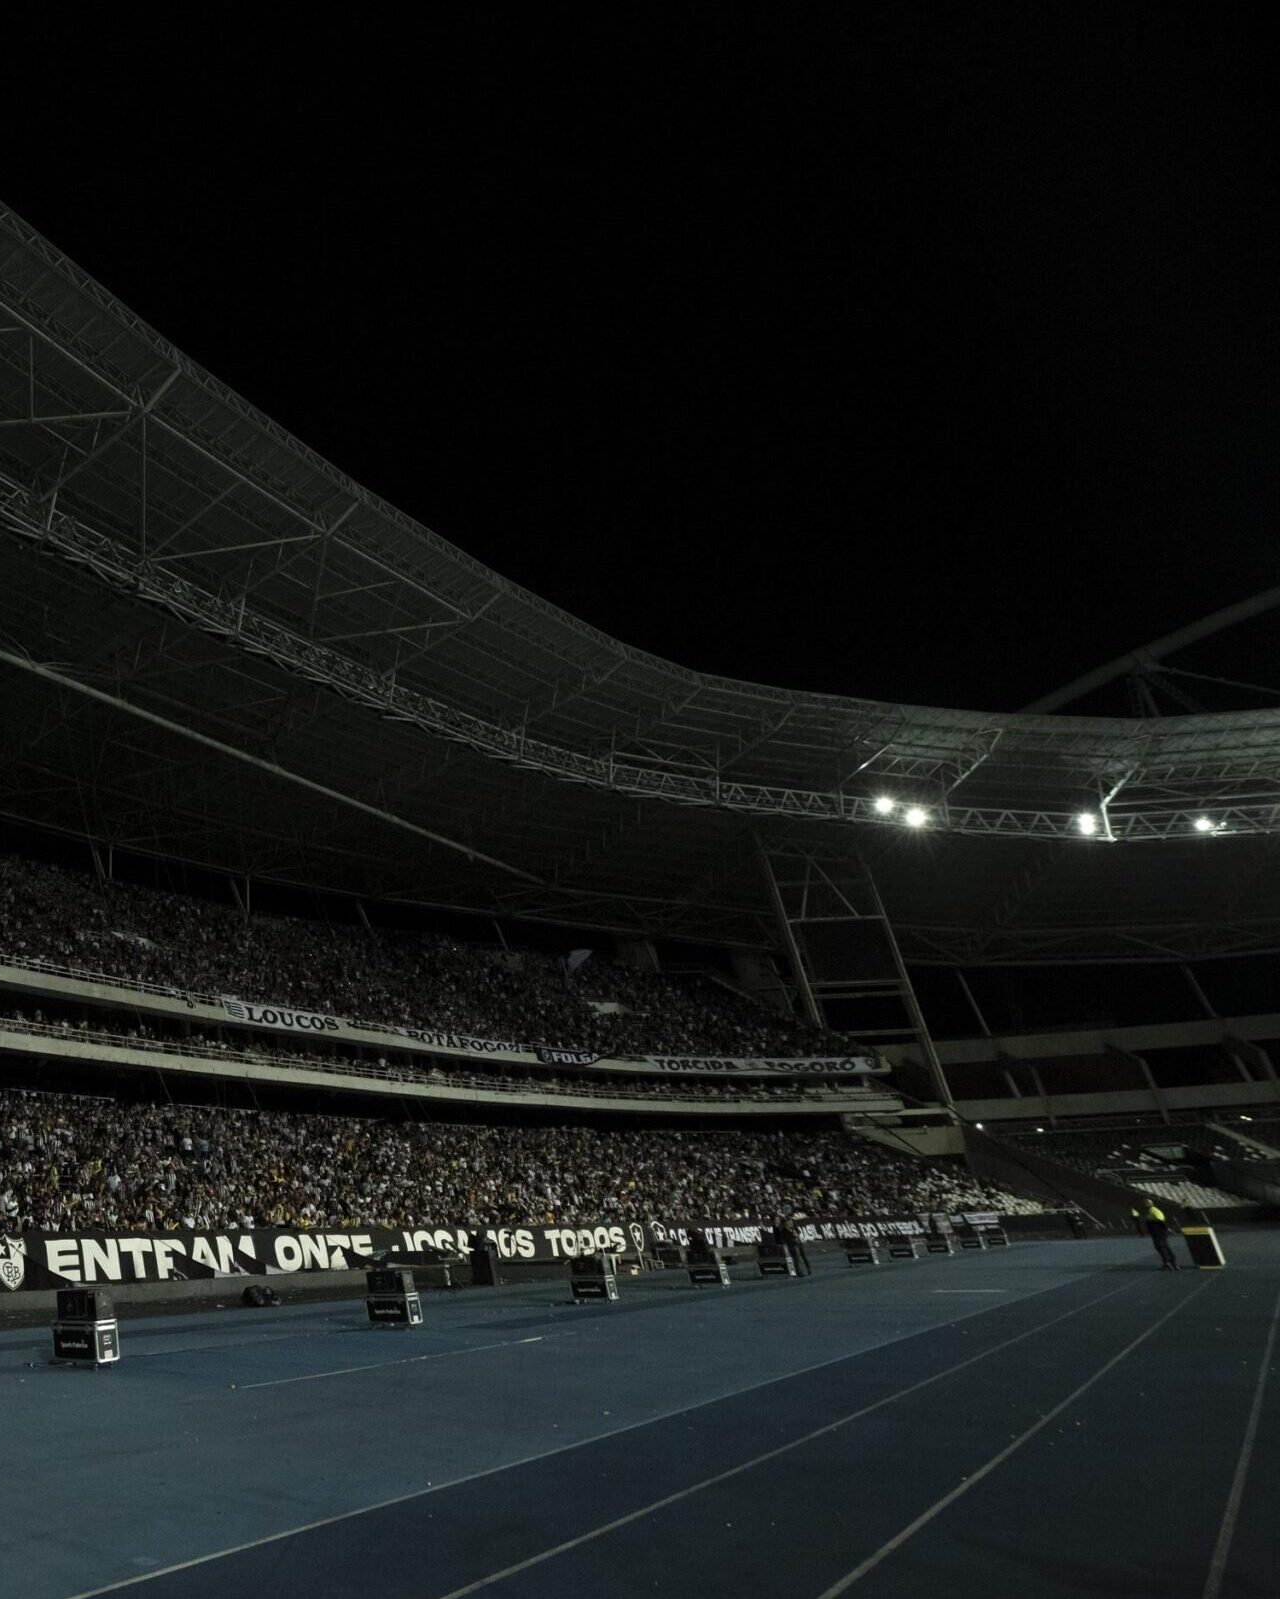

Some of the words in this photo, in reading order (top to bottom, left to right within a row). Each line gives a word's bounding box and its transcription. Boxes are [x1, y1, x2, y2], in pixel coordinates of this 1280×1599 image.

[244, 1006, 339, 1030] LOUCOS
[654, 1058, 739, 1071] TORCIDA
[544, 1226, 627, 1258] TODOS
